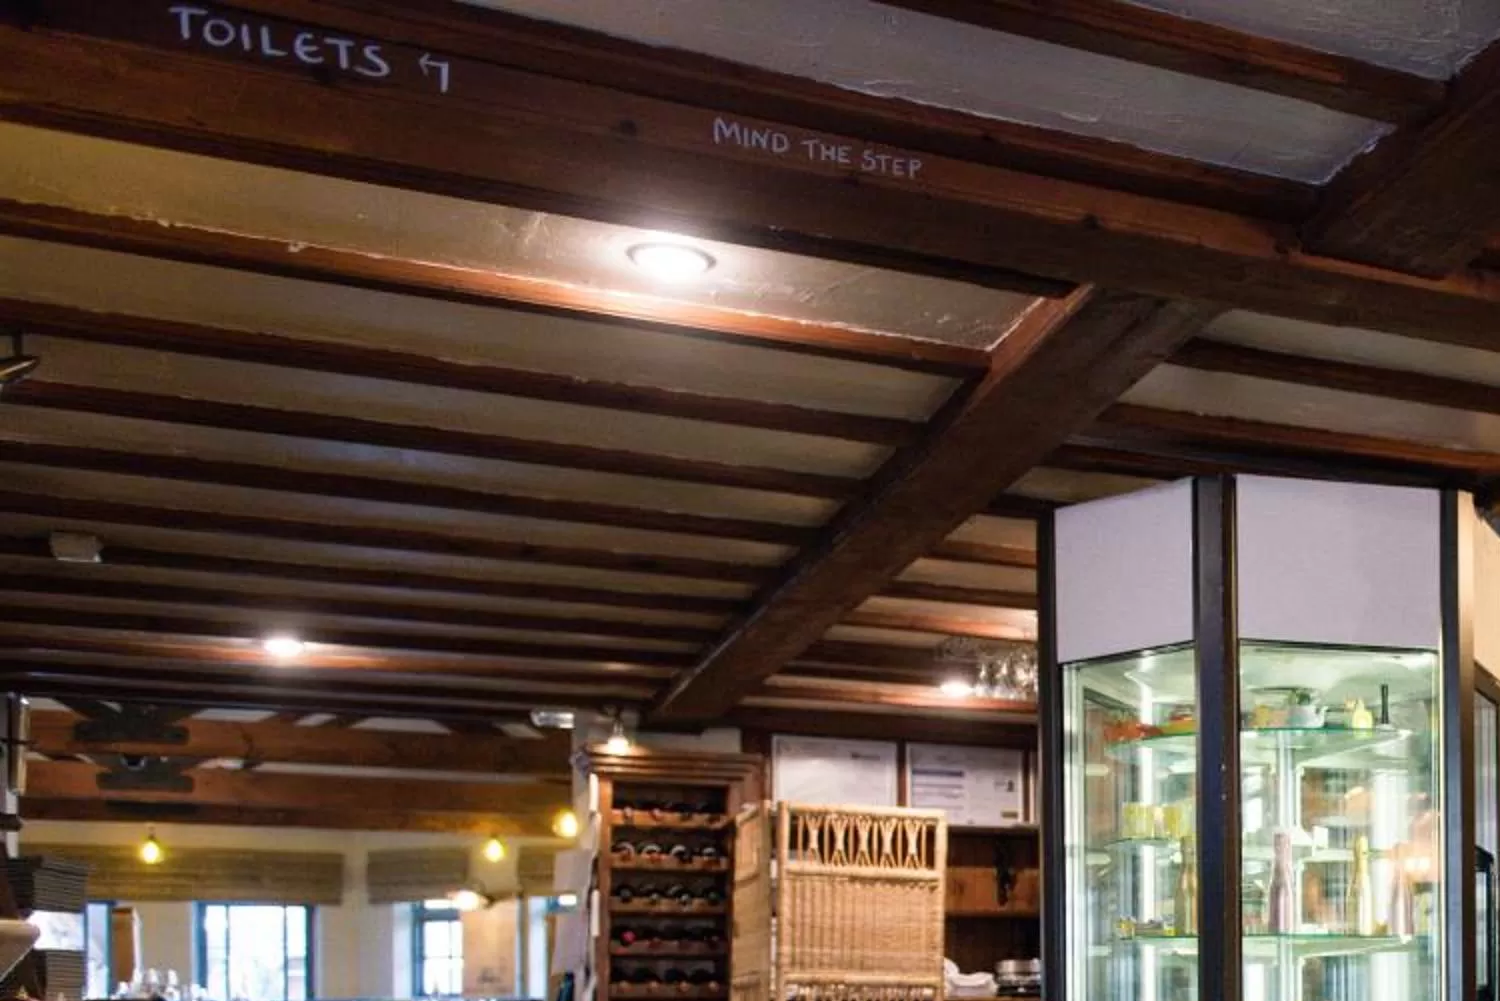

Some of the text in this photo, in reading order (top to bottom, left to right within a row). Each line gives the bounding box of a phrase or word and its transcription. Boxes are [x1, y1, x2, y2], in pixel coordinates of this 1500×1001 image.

[167, 5, 391, 78] TOILETS
[713, 116, 923, 179] MIND THE STEP
